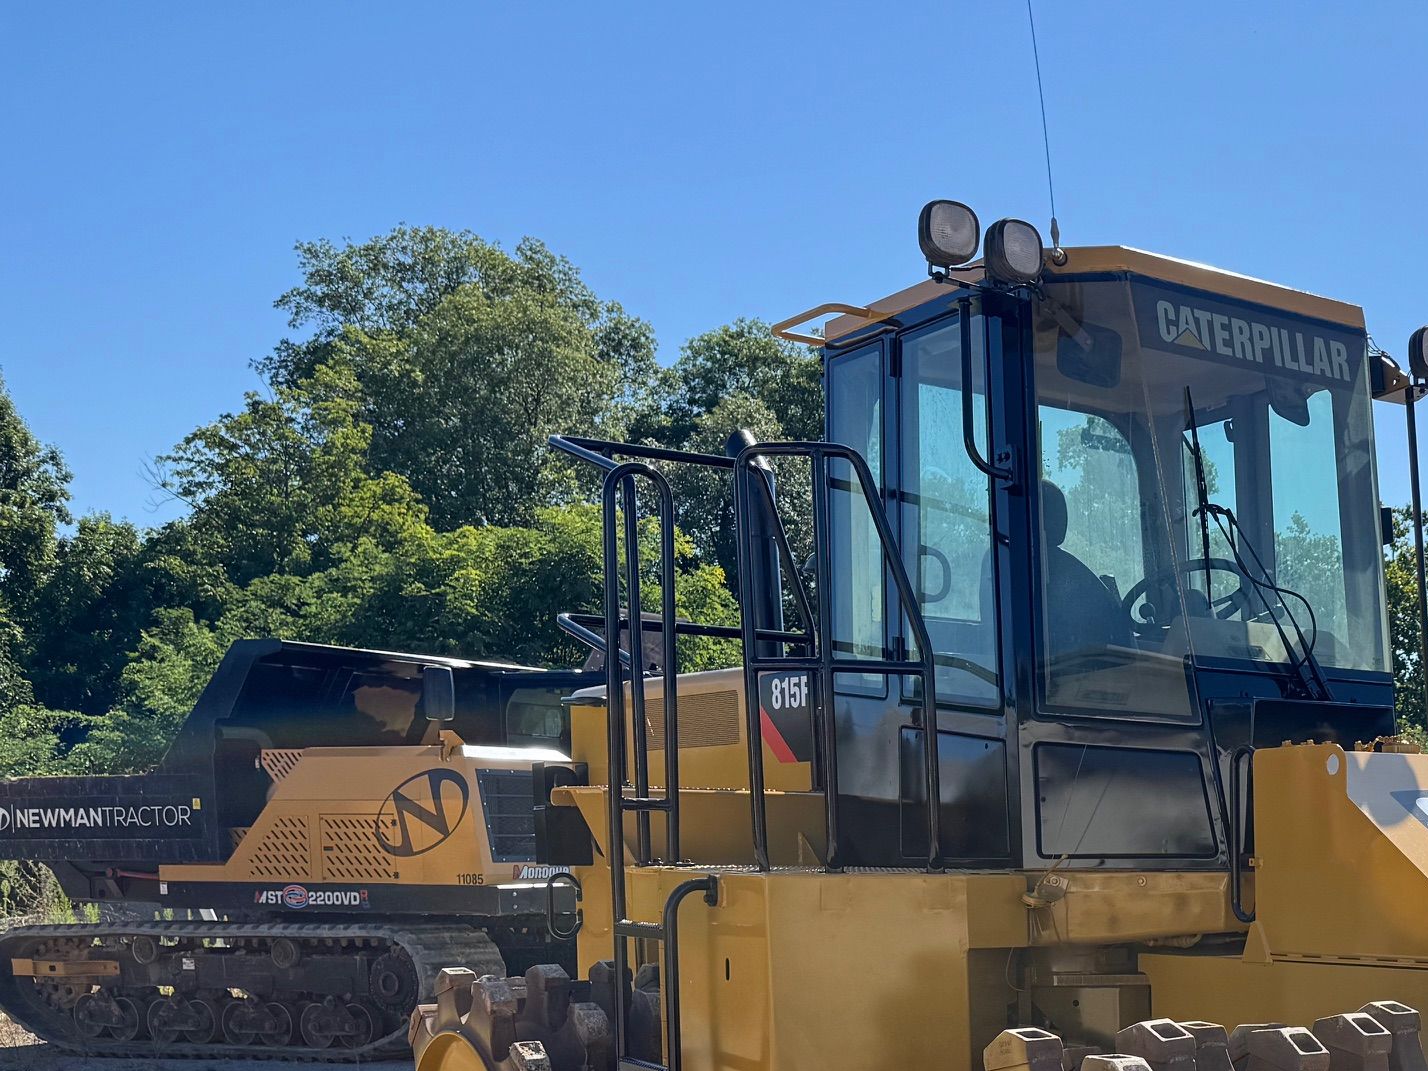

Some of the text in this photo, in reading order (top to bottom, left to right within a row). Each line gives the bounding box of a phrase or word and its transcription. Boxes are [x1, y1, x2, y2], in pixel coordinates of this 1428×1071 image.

[1157, 300, 1351, 381] CATERPILLAR
[772, 675, 808, 709] 815F
[457, 874, 484, 885] 11085
[255, 891, 282, 904] MST
